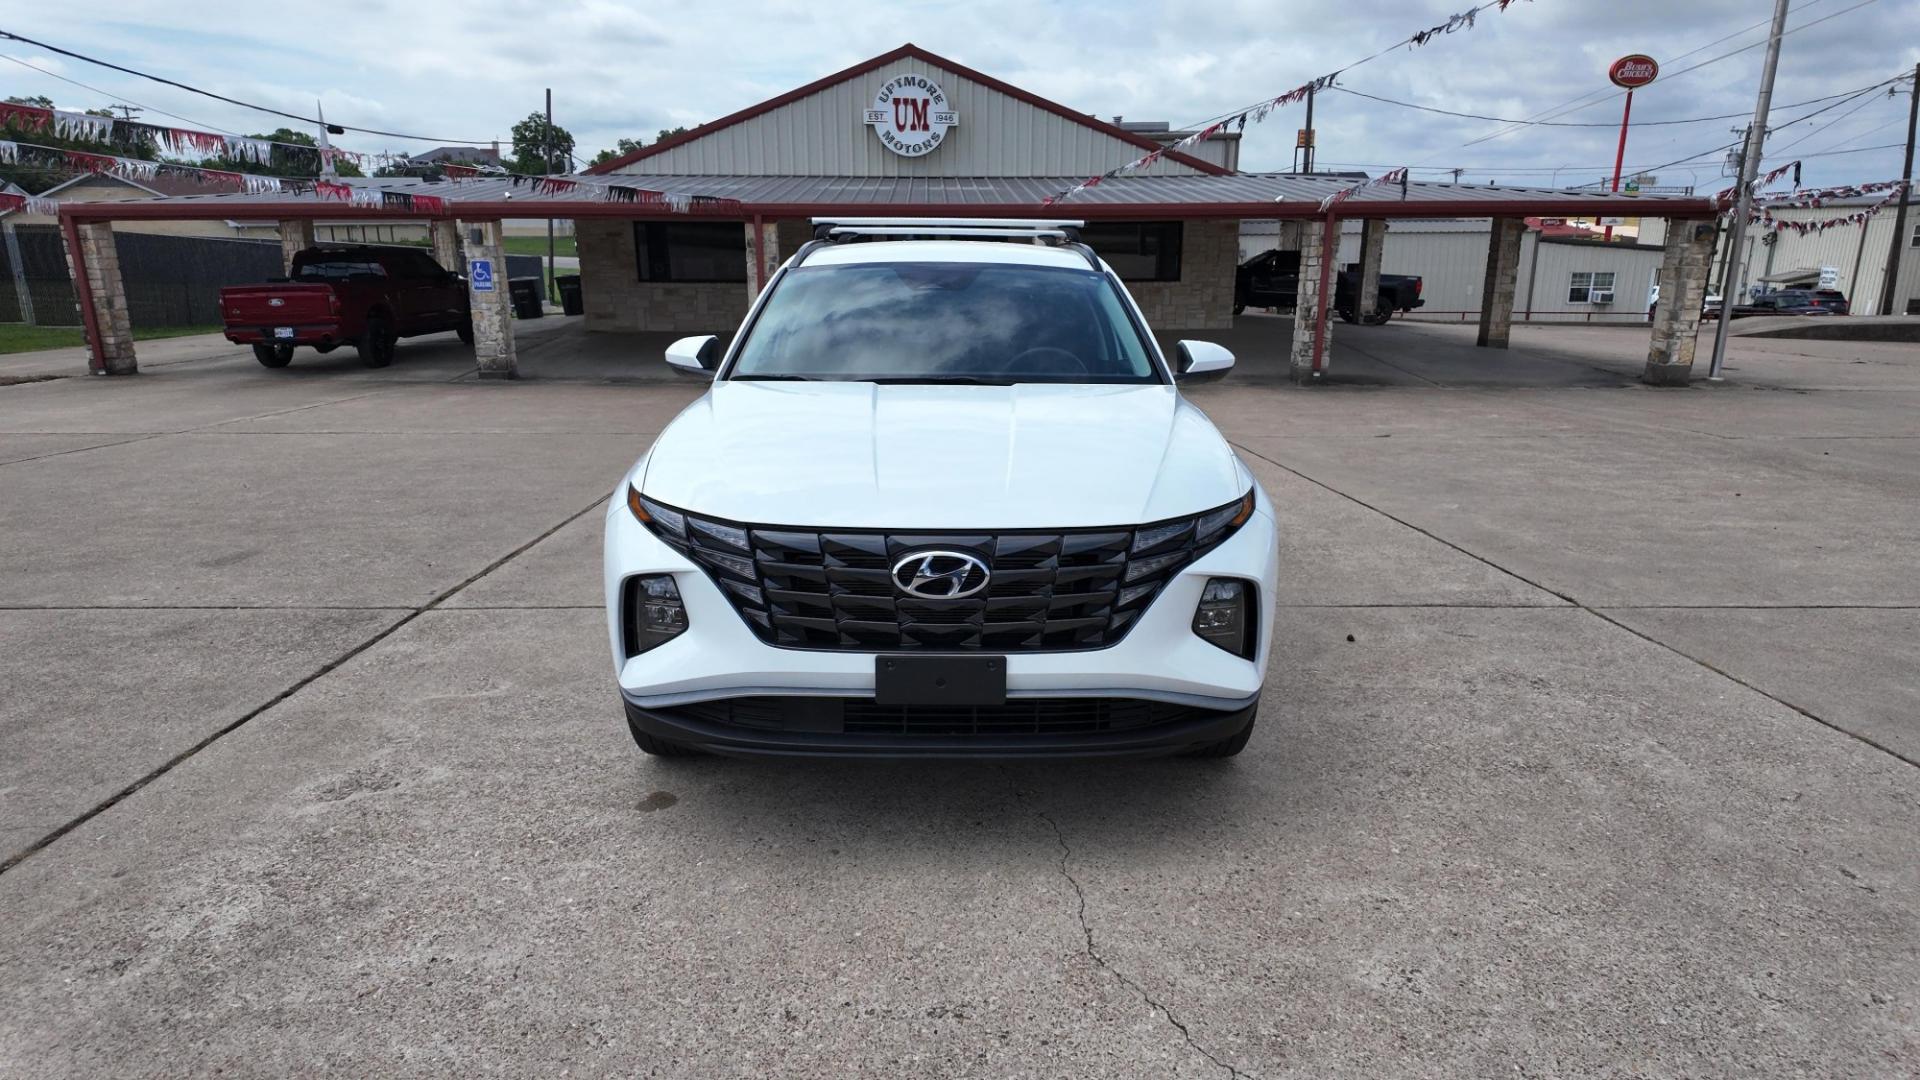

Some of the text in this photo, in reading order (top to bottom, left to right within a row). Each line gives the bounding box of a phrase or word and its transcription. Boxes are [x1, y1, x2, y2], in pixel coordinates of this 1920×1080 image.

[878, 76, 944, 105] UPTMORE
[892, 97, 930, 133] UM
[935, 114, 954, 122] 1946
[882, 130, 941, 154] MOTORS
